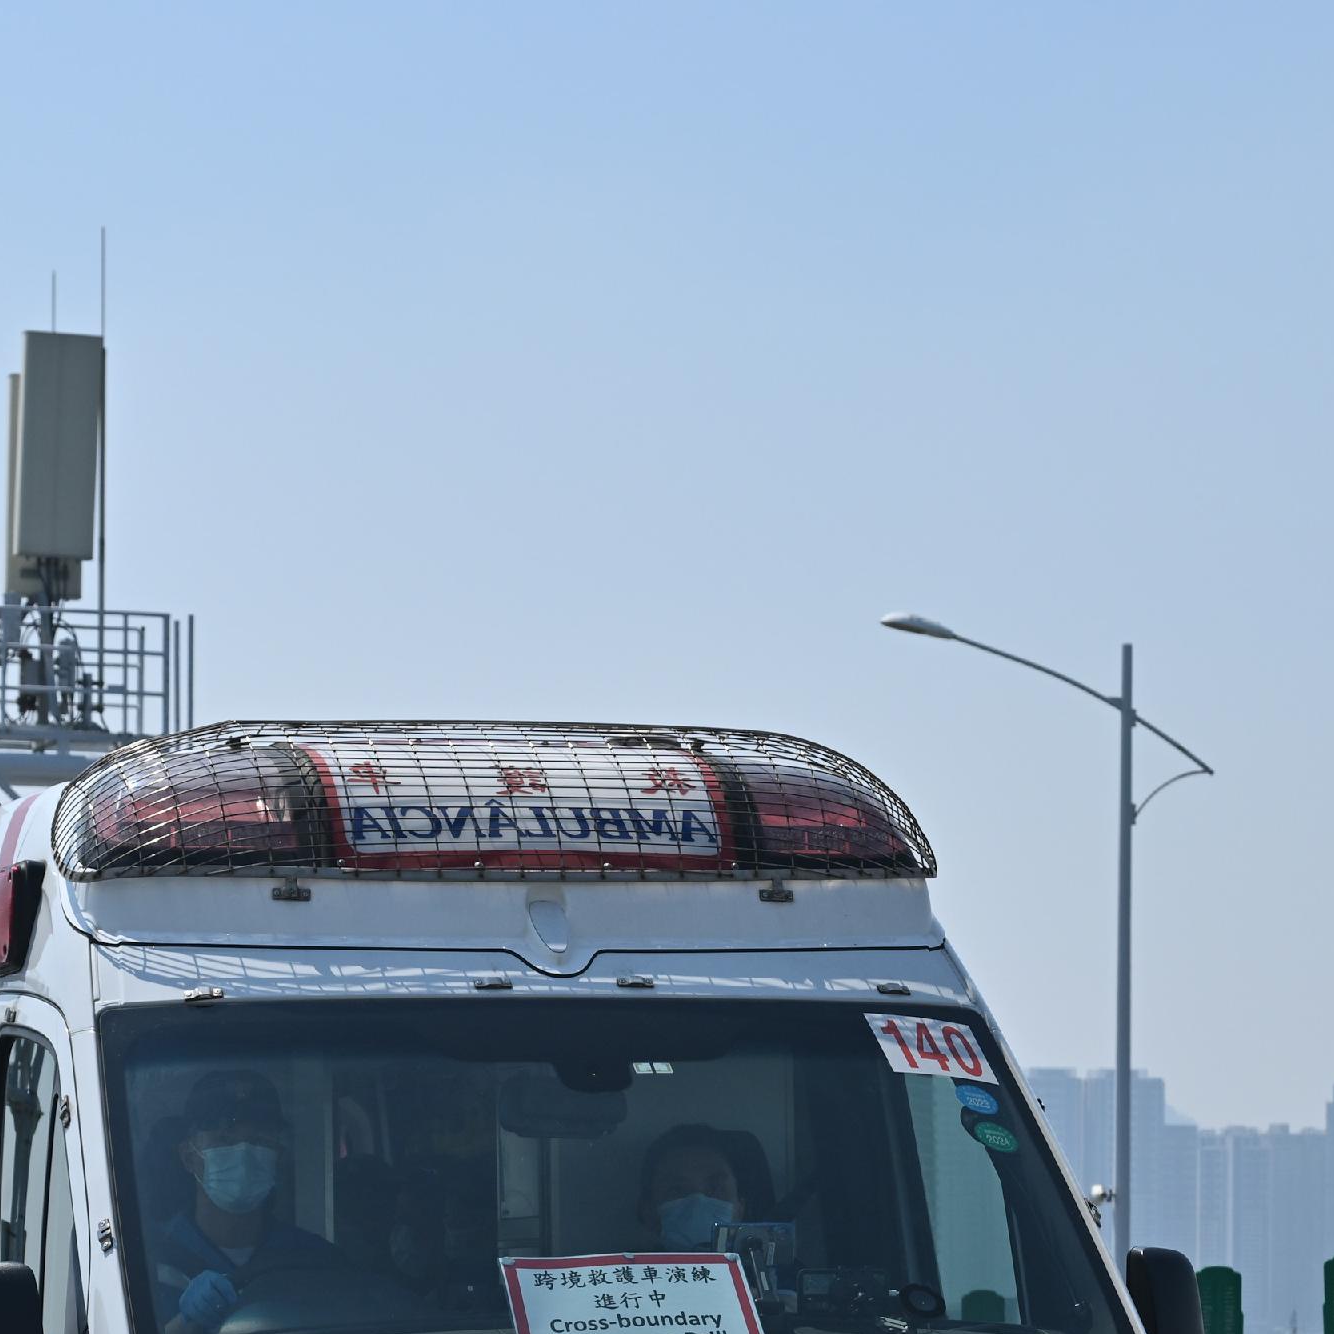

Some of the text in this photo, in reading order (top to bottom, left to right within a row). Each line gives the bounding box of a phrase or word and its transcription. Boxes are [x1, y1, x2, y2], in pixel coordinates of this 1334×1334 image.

[881, 1020, 983, 1077] 140
[533, 1266, 717, 1290] 跨境救護車演練
[594, 1289, 667, 1310] 進行中
[550, 1311, 722, 1333] Cross-boundary
